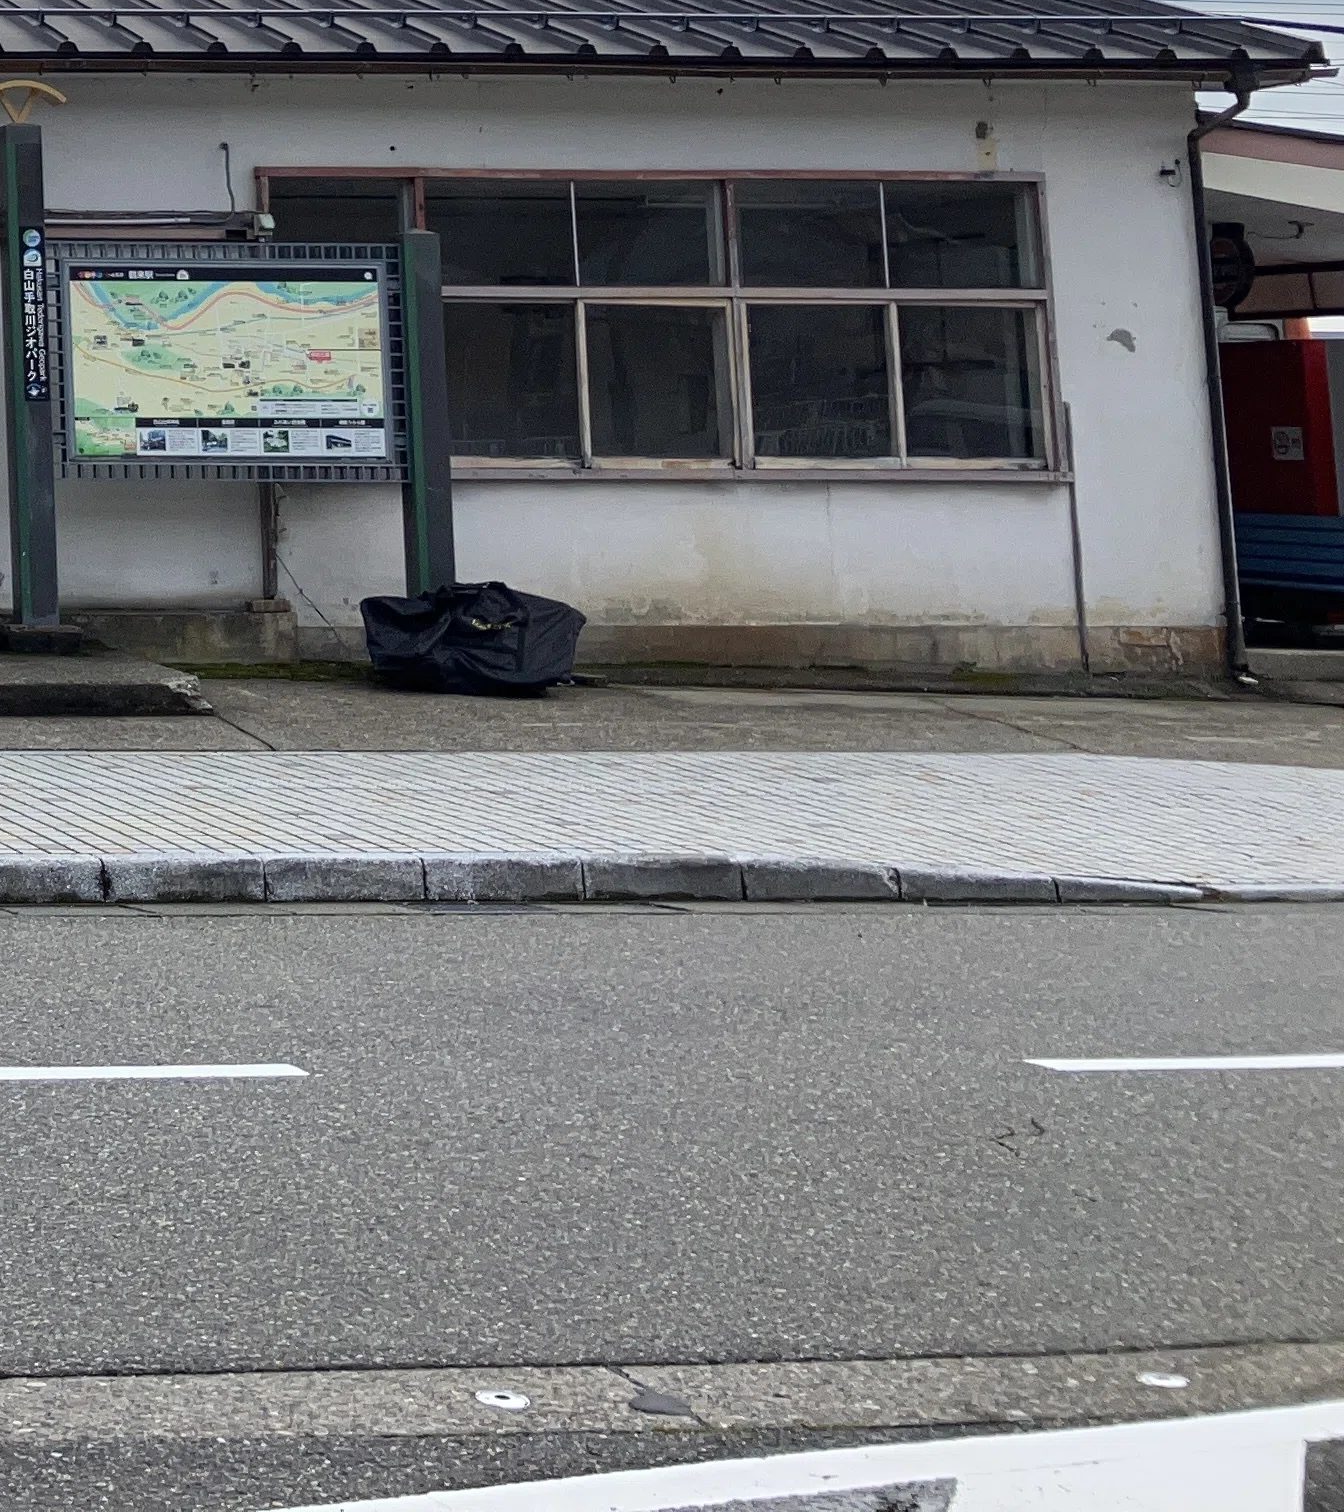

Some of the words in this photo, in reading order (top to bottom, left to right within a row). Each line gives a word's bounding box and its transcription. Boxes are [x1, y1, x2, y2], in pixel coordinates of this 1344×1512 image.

[35, 268, 44, 301] Hakusan
[23, 269, 38, 382] 白山手取川ジオパーク
[38, 348, 48, 382] Geopark
